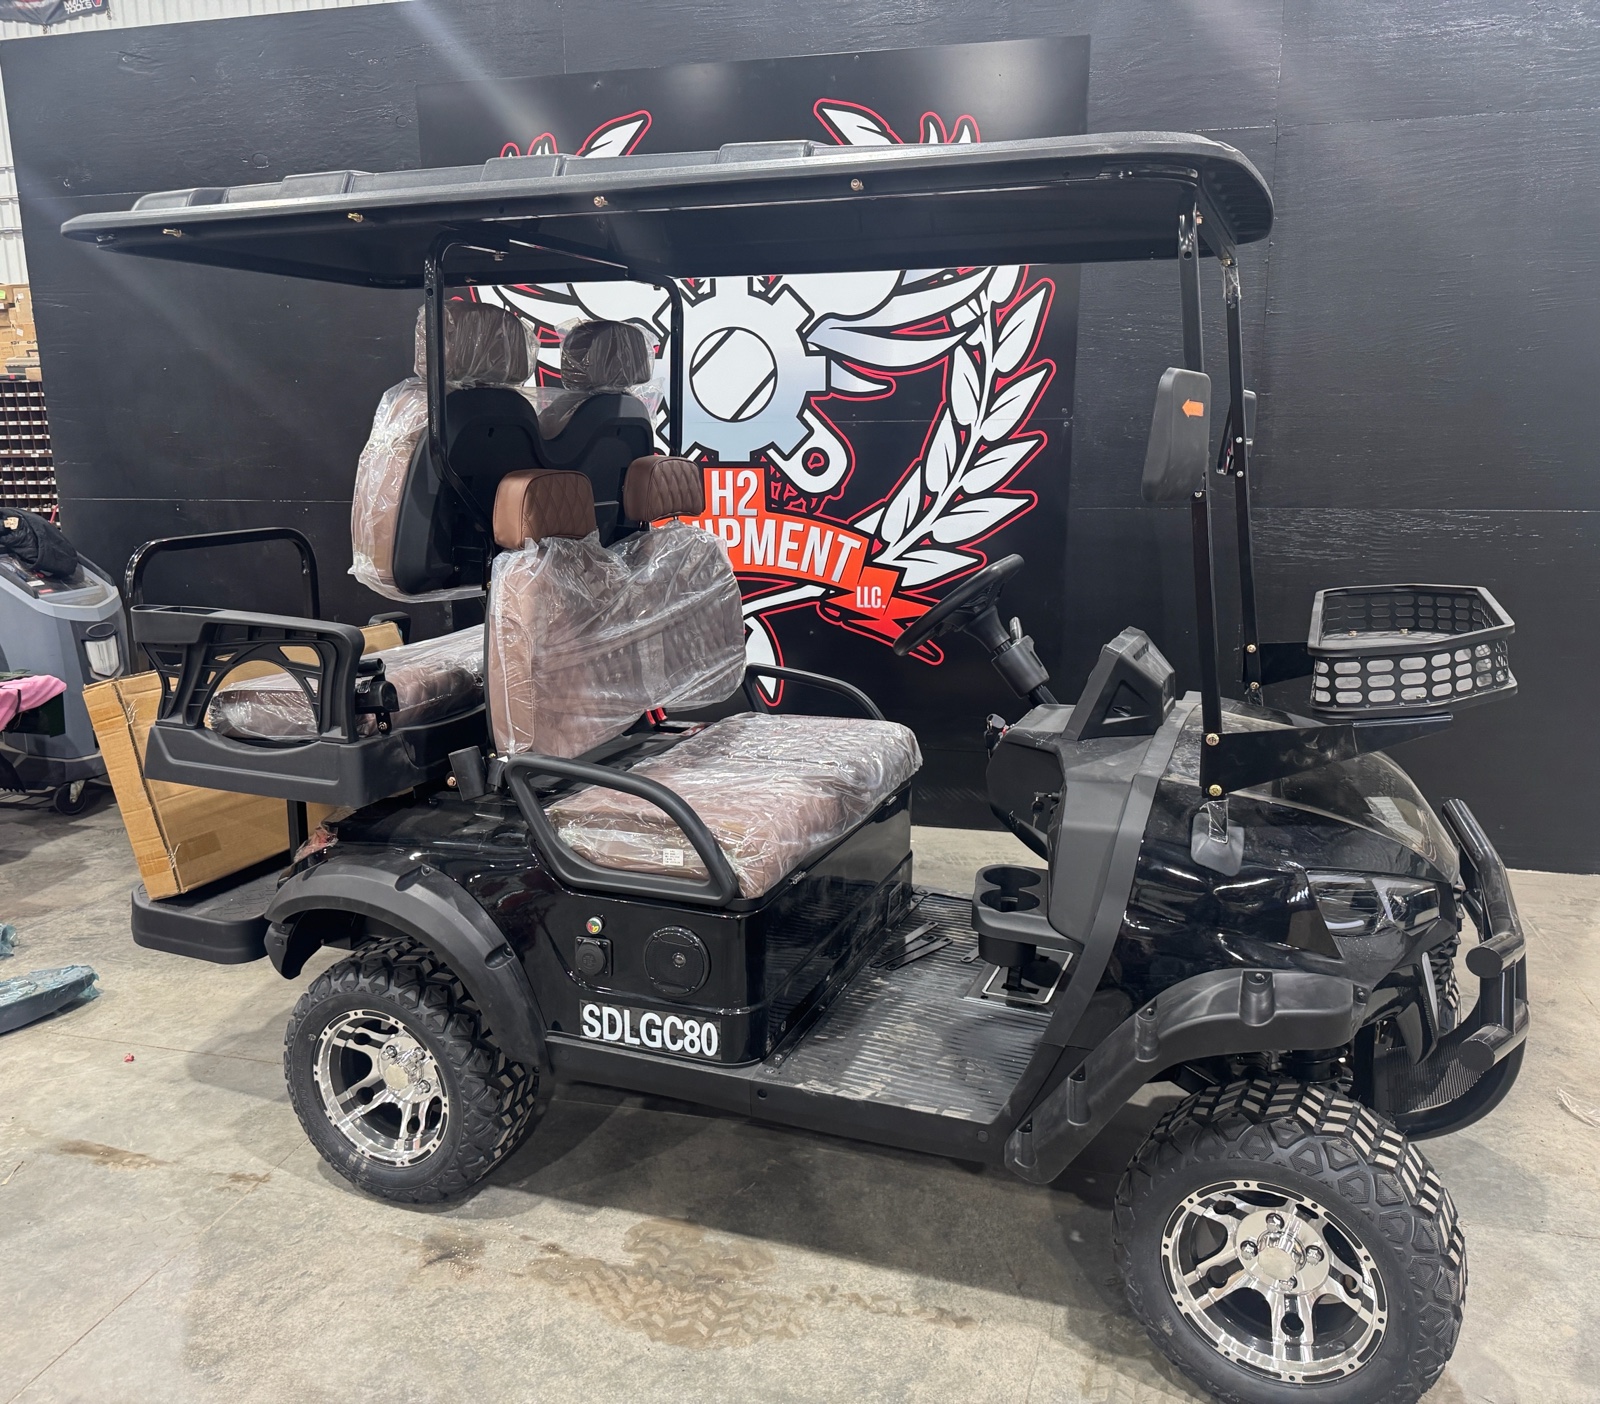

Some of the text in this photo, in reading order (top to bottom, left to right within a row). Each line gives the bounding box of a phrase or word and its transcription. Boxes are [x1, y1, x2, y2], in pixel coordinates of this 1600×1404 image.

[65, 2, 92, 14] TOOLS
[710, 470, 758, 517] H2
[691, 517, 862, 583] PMENT
[856, 586, 886, 609] LLC.
[582, 1003, 719, 1057] SDLGC80
